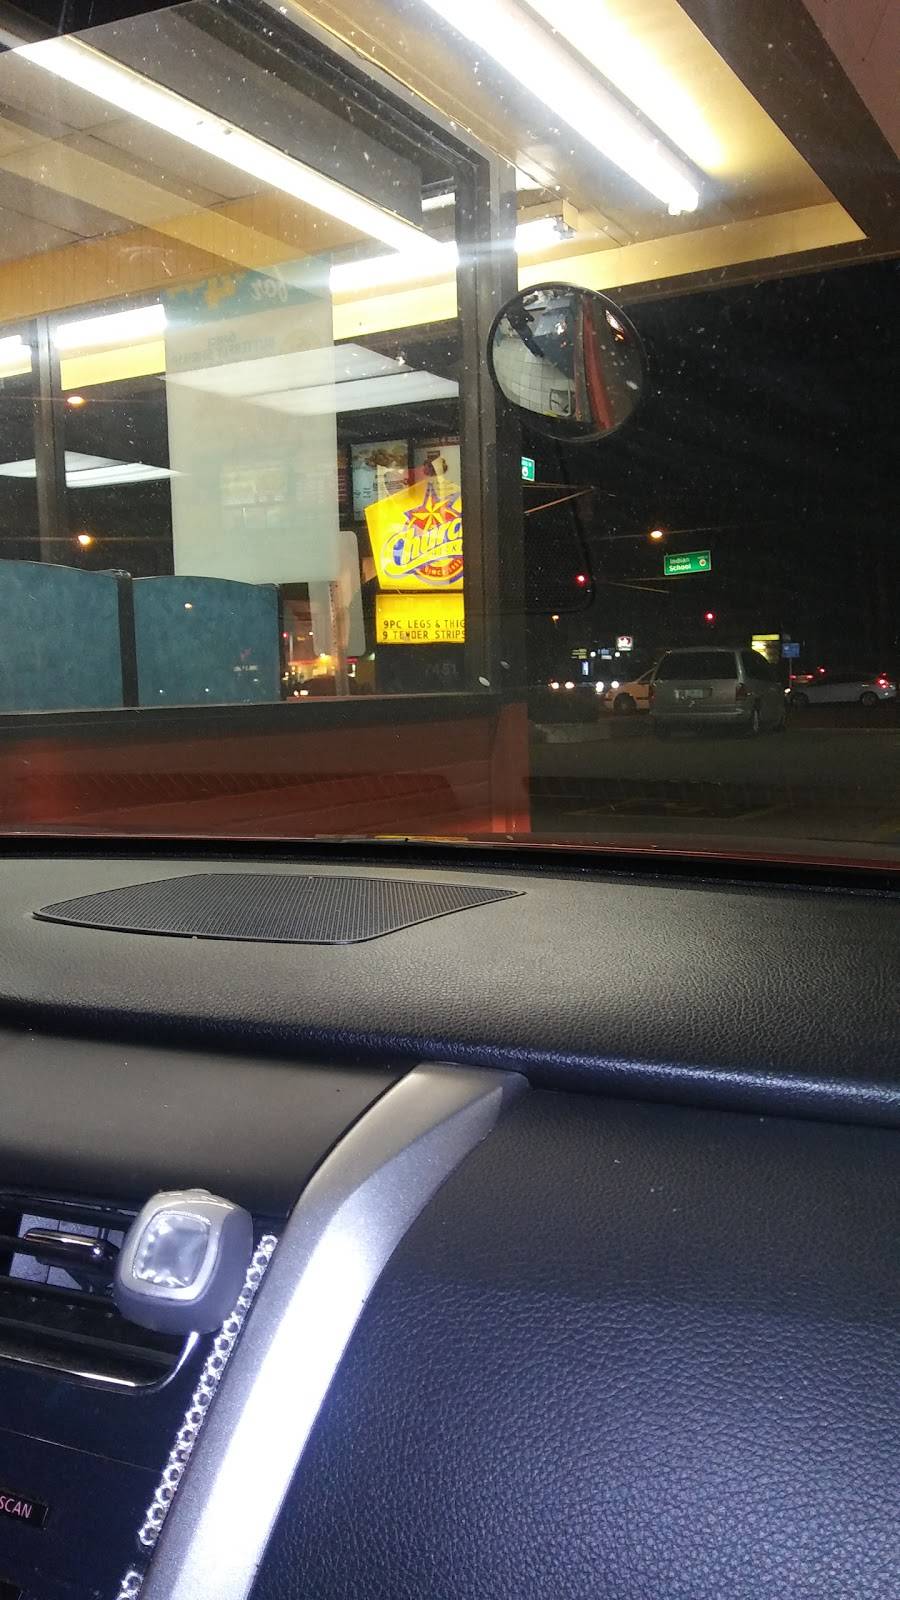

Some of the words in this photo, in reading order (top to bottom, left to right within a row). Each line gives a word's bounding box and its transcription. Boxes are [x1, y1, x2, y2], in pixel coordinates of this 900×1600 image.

[669, 563, 691, 571] School
[383, 619, 402, 629] 9PC
[407, 619, 431, 629] LEGS
[382, 631, 388, 640] 9
[0, 1495, 33, 1519] SCAN
